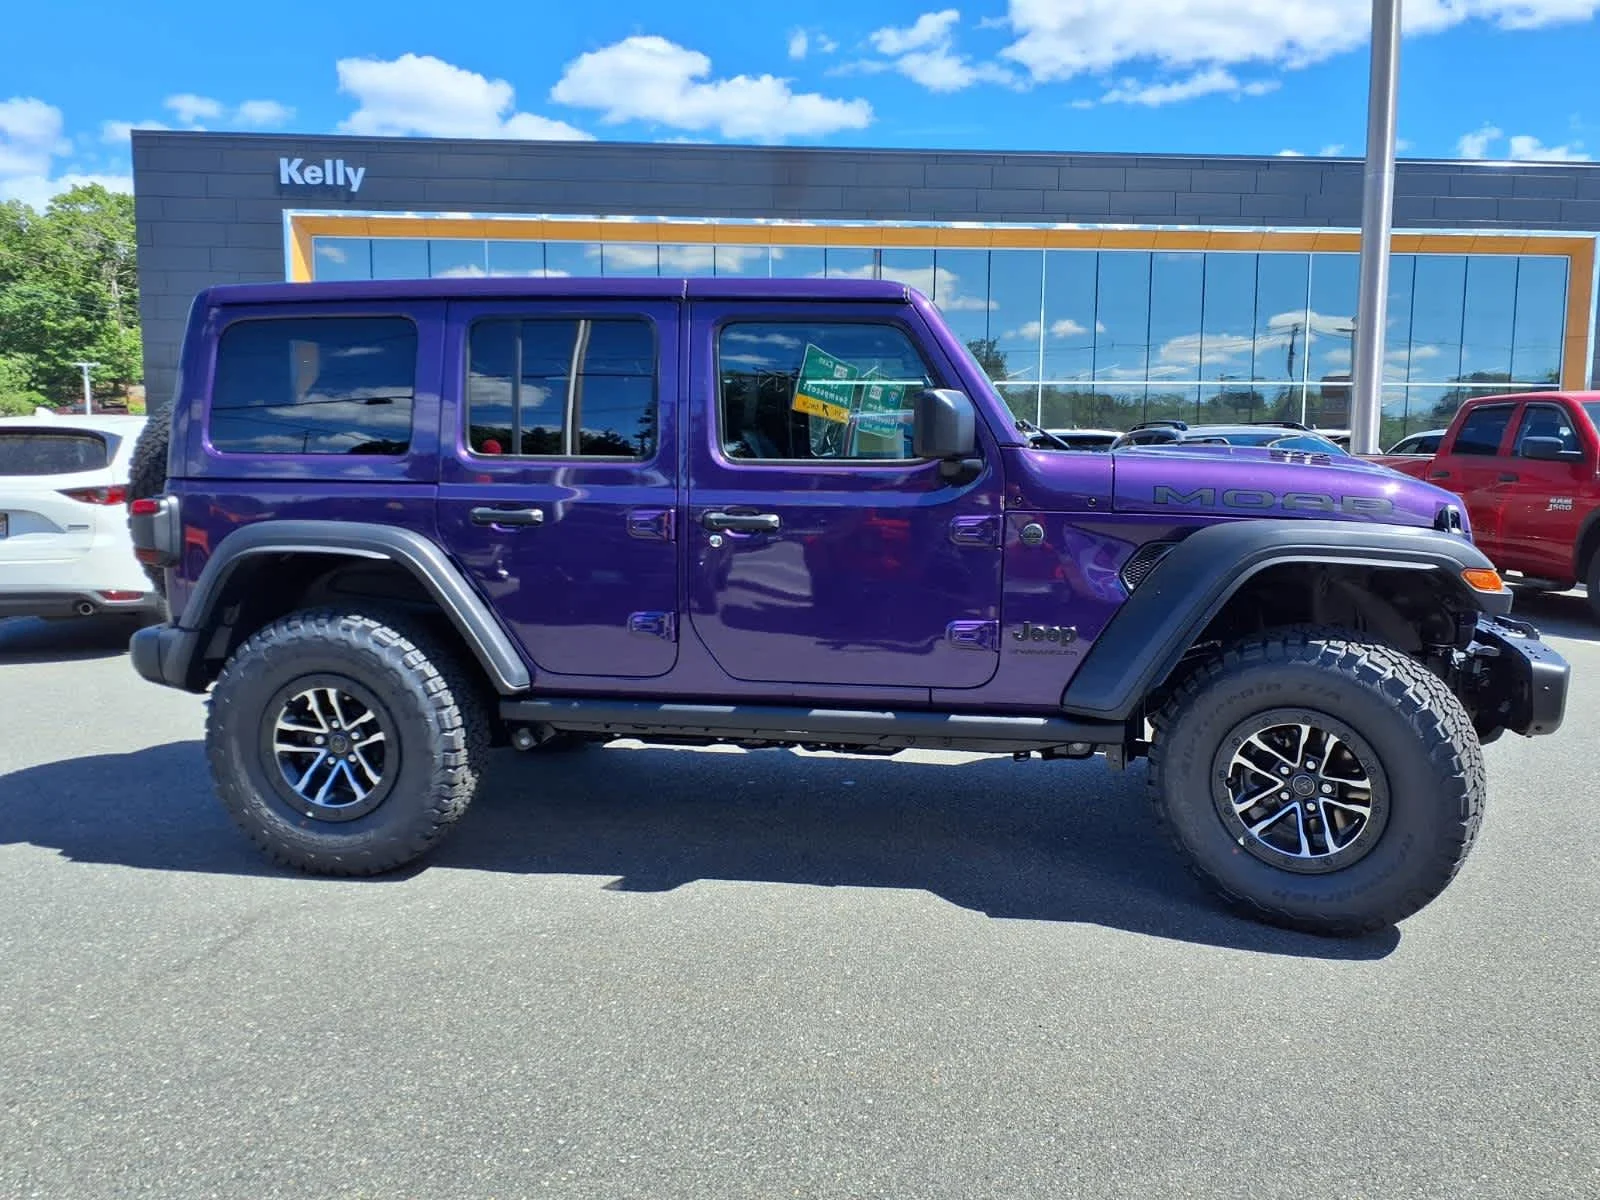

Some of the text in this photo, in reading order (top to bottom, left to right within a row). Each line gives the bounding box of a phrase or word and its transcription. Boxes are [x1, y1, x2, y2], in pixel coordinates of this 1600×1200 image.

[280, 157, 366, 193] Kelly
[1152, 484, 1394, 514] MOAB
[1012, 620, 1077, 647] Jeep
